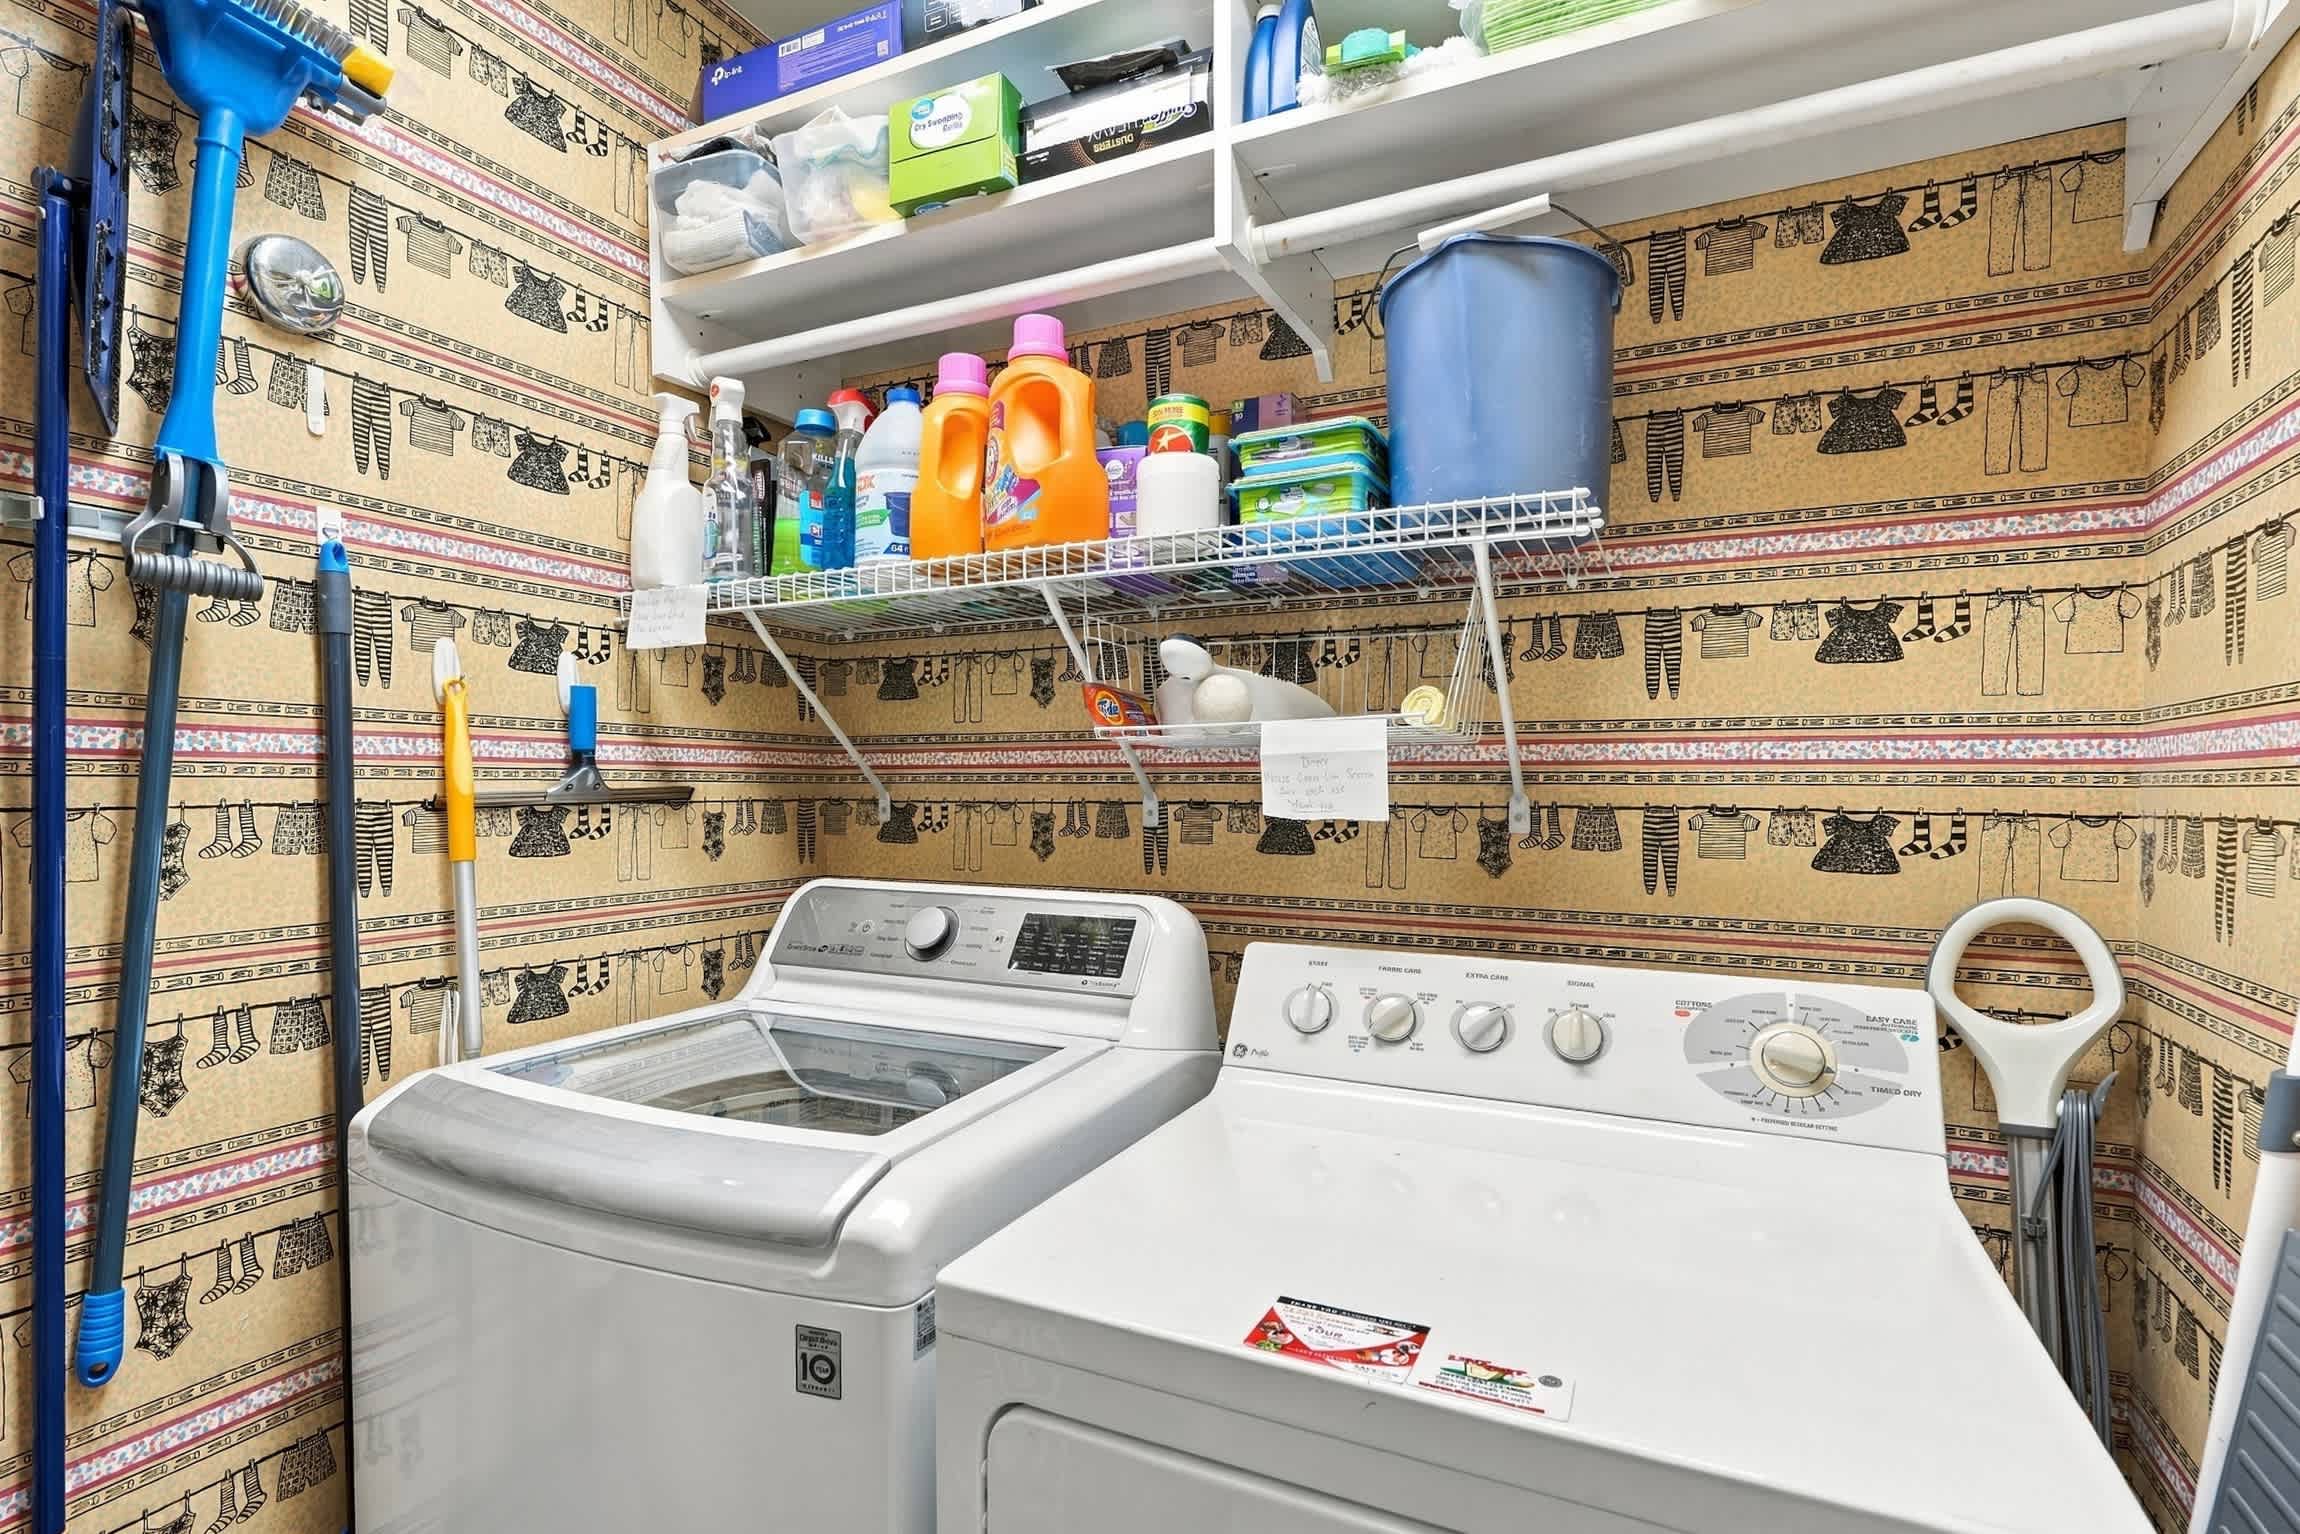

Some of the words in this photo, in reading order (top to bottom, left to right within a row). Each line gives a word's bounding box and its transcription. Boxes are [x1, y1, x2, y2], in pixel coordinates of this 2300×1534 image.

[1093, 133, 1134, 153] DUSTERS
[812, 453, 834, 465] KILLS
[1097, 698, 1119, 717] Tide
[1378, 965, 1402, 973] FABRIC
[1465, 972, 1489, 980] EXTRA
[1567, 980, 1595, 988] SIGNAL
[1675, 1000, 1712, 1008] COTTONS
[1866, 1015, 1890, 1024] EASY
[1871, 1086, 1901, 1096] TIMED
[1903, 1090, 1922, 1098] DRY
[800, 1352, 836, 1384] 10
